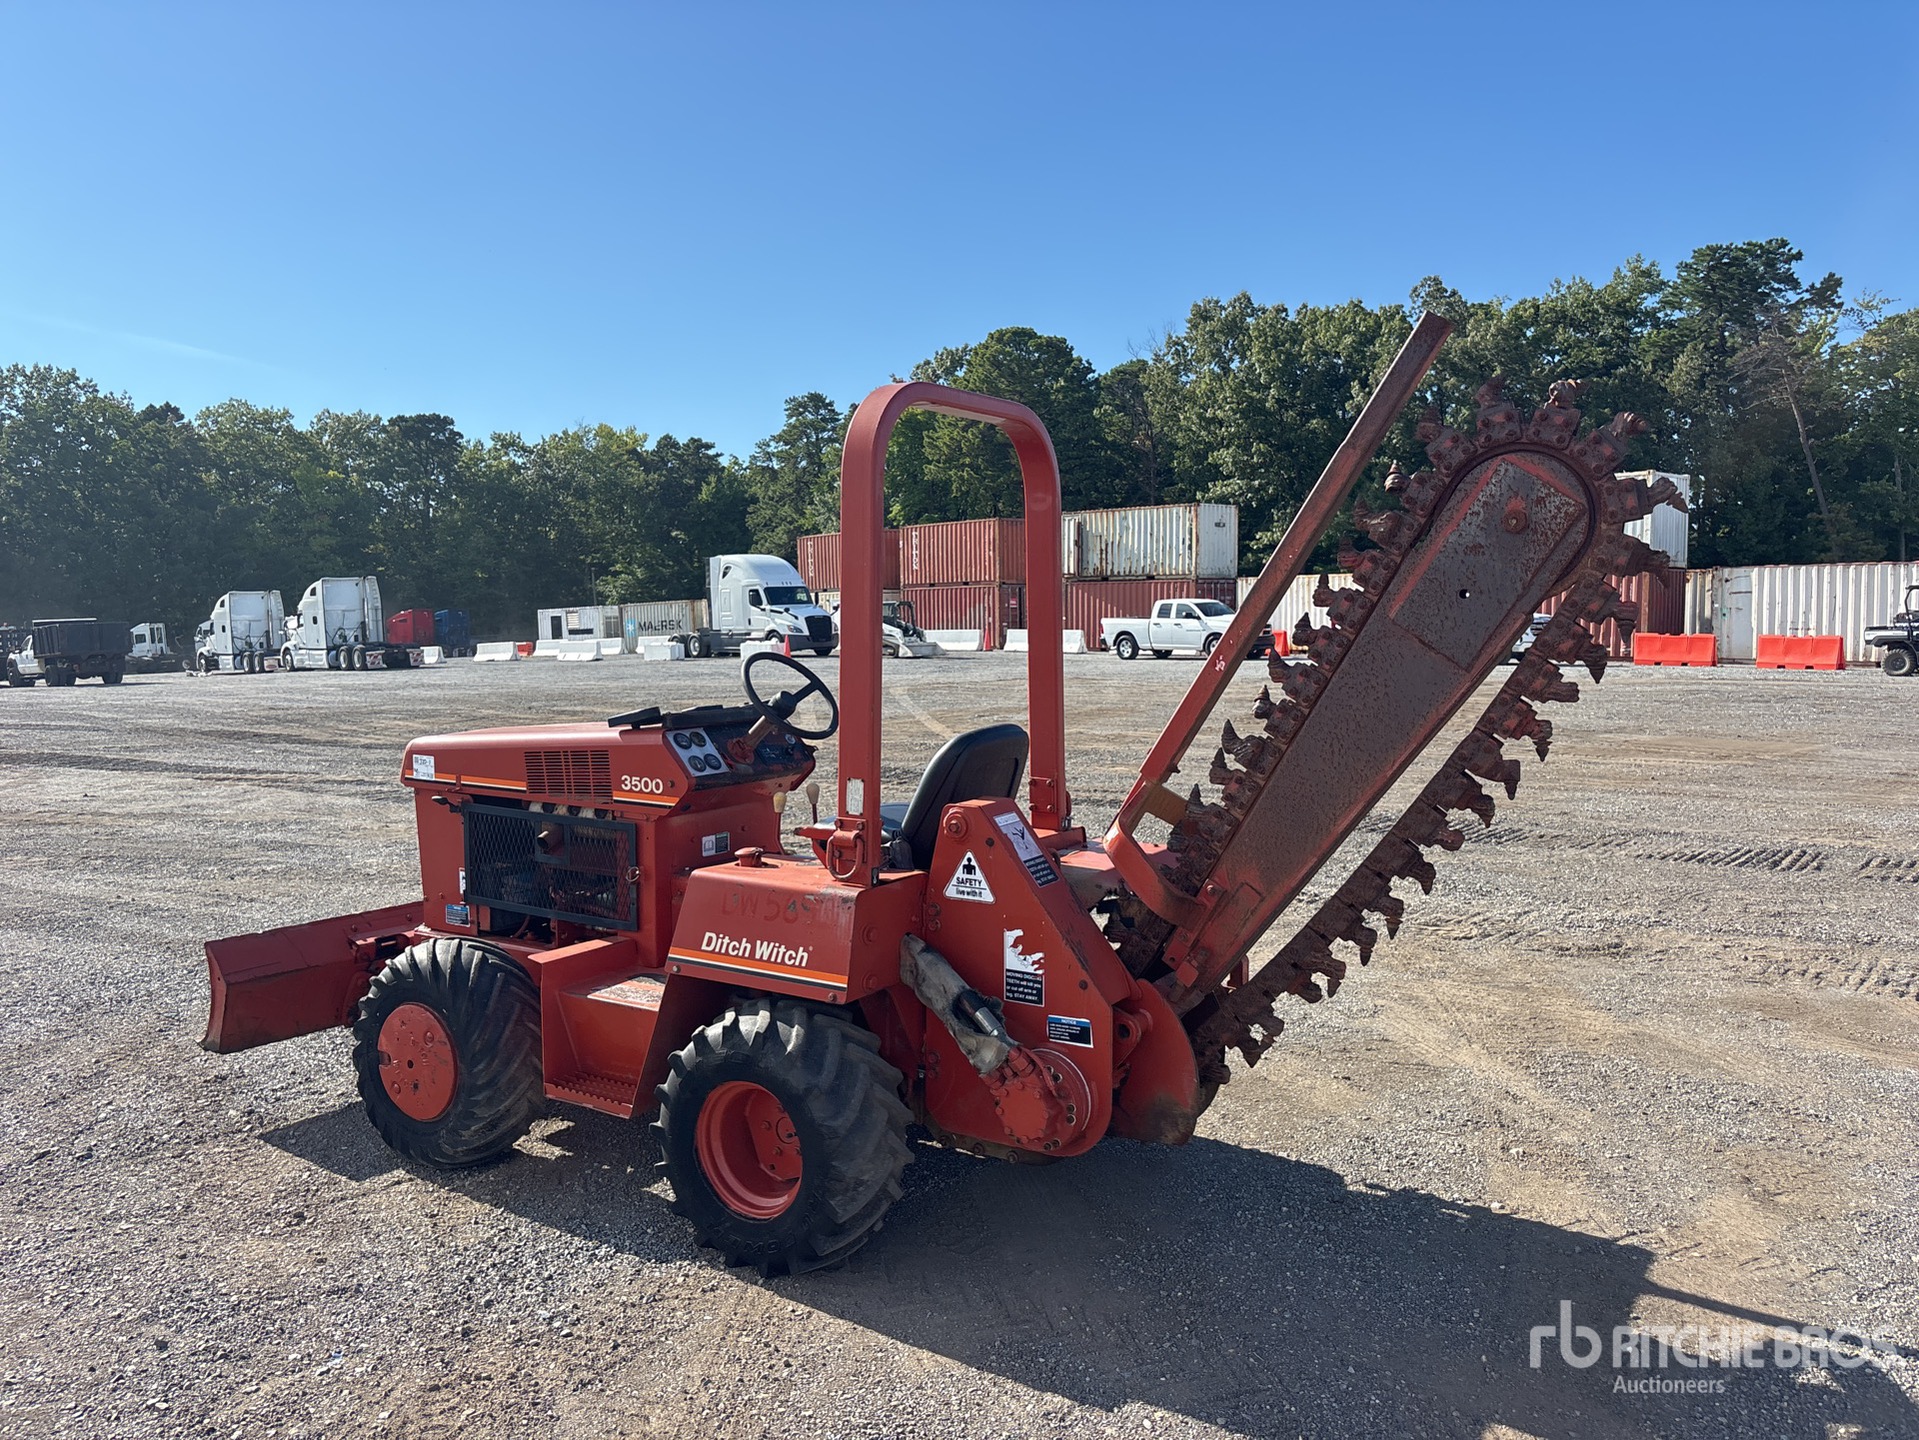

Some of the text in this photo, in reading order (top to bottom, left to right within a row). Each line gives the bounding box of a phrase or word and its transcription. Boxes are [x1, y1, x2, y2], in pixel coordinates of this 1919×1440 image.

[638, 619, 683, 632] MAERSK
[621, 774, 664, 794] 3500
[956, 876, 983, 887] SAFETY
[701, 931, 809, 967] Ditch Witch
